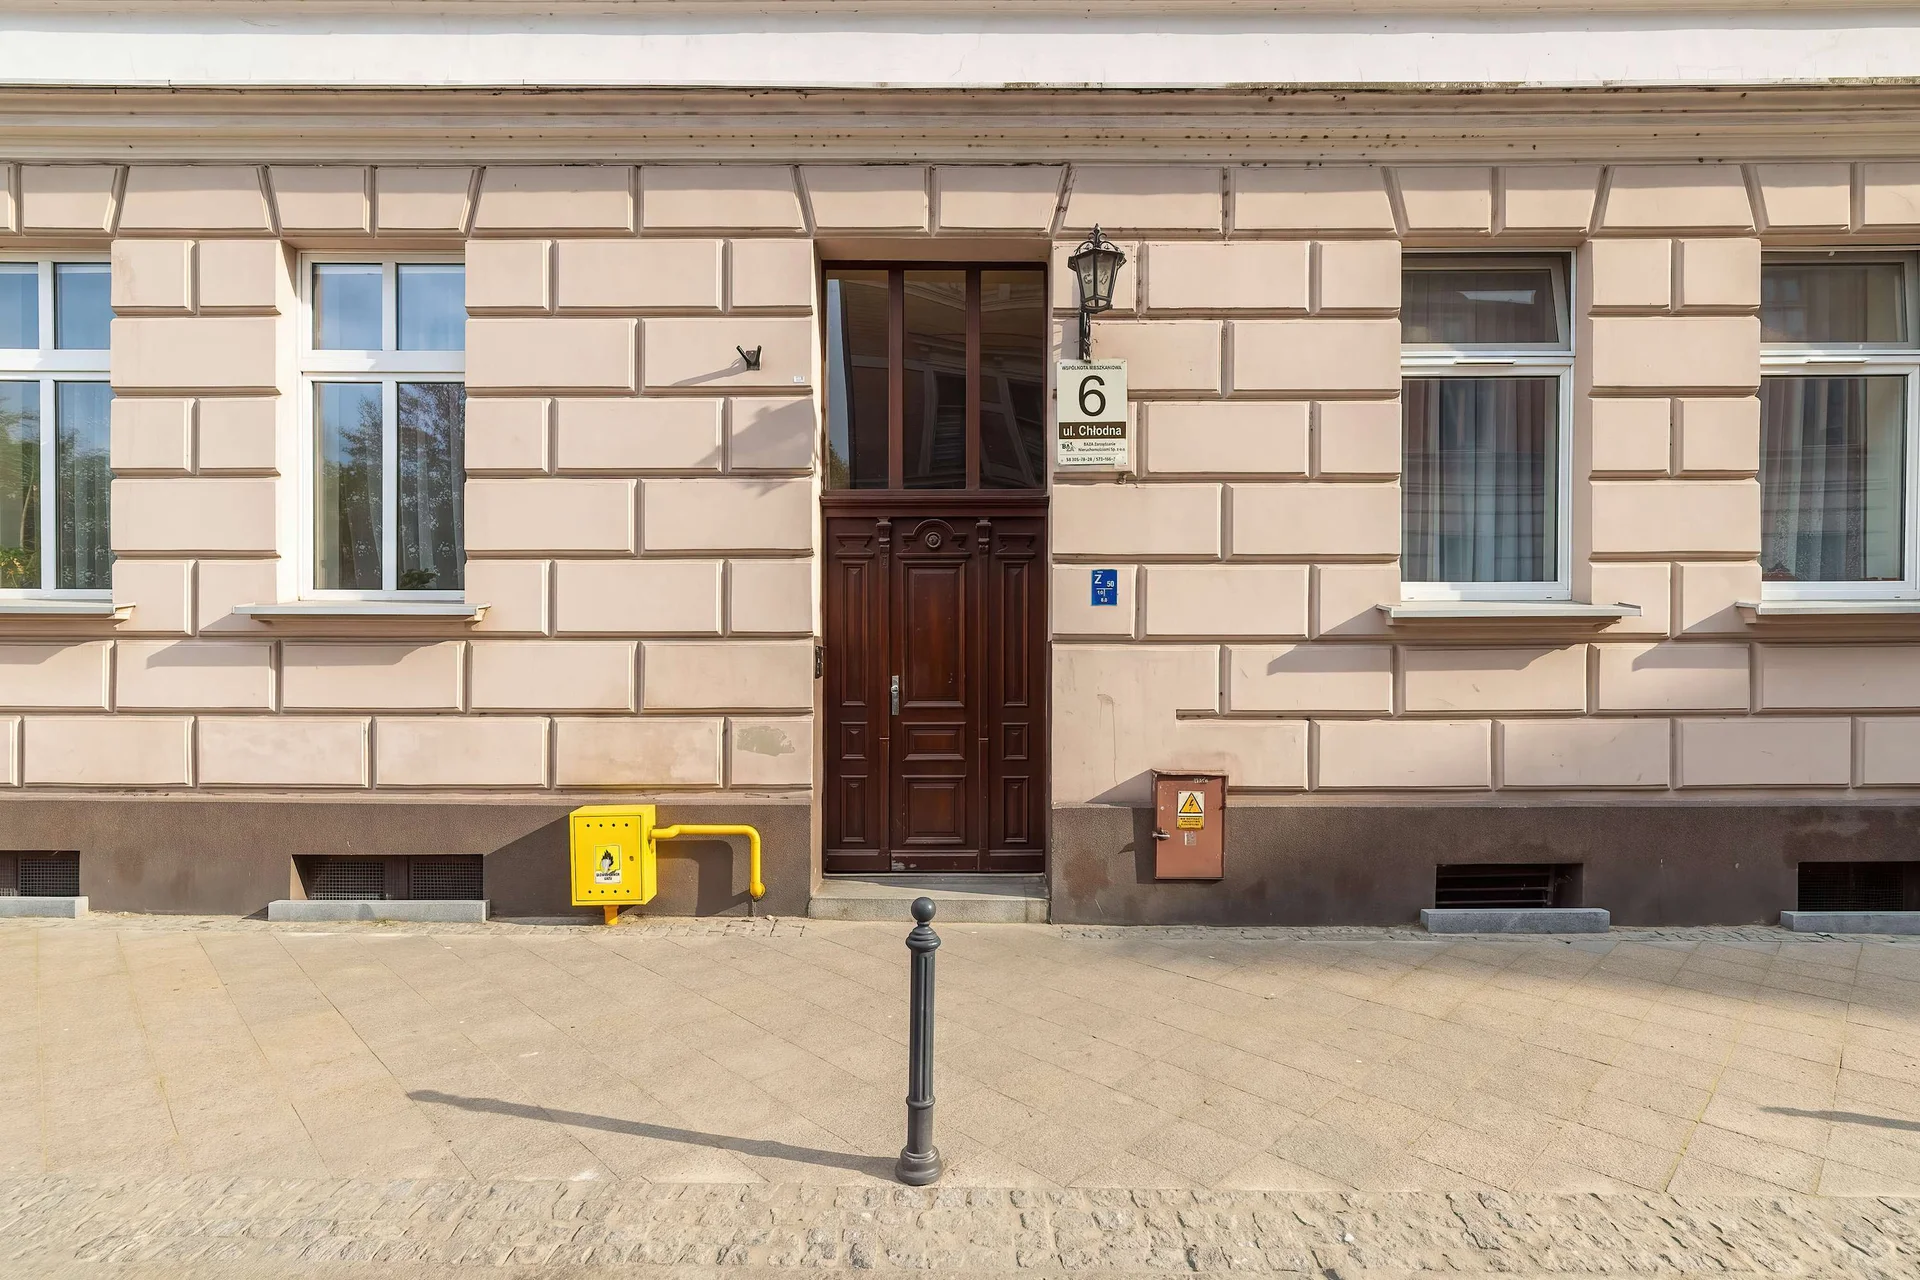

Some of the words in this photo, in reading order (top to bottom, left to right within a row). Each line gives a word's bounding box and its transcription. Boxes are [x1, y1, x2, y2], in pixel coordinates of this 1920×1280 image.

[1079, 375, 1106, 417] 6
[1063, 425, 1076, 436] ul.
[1078, 425, 1122, 436] Chłodna
[1094, 574, 1102, 584] Z
